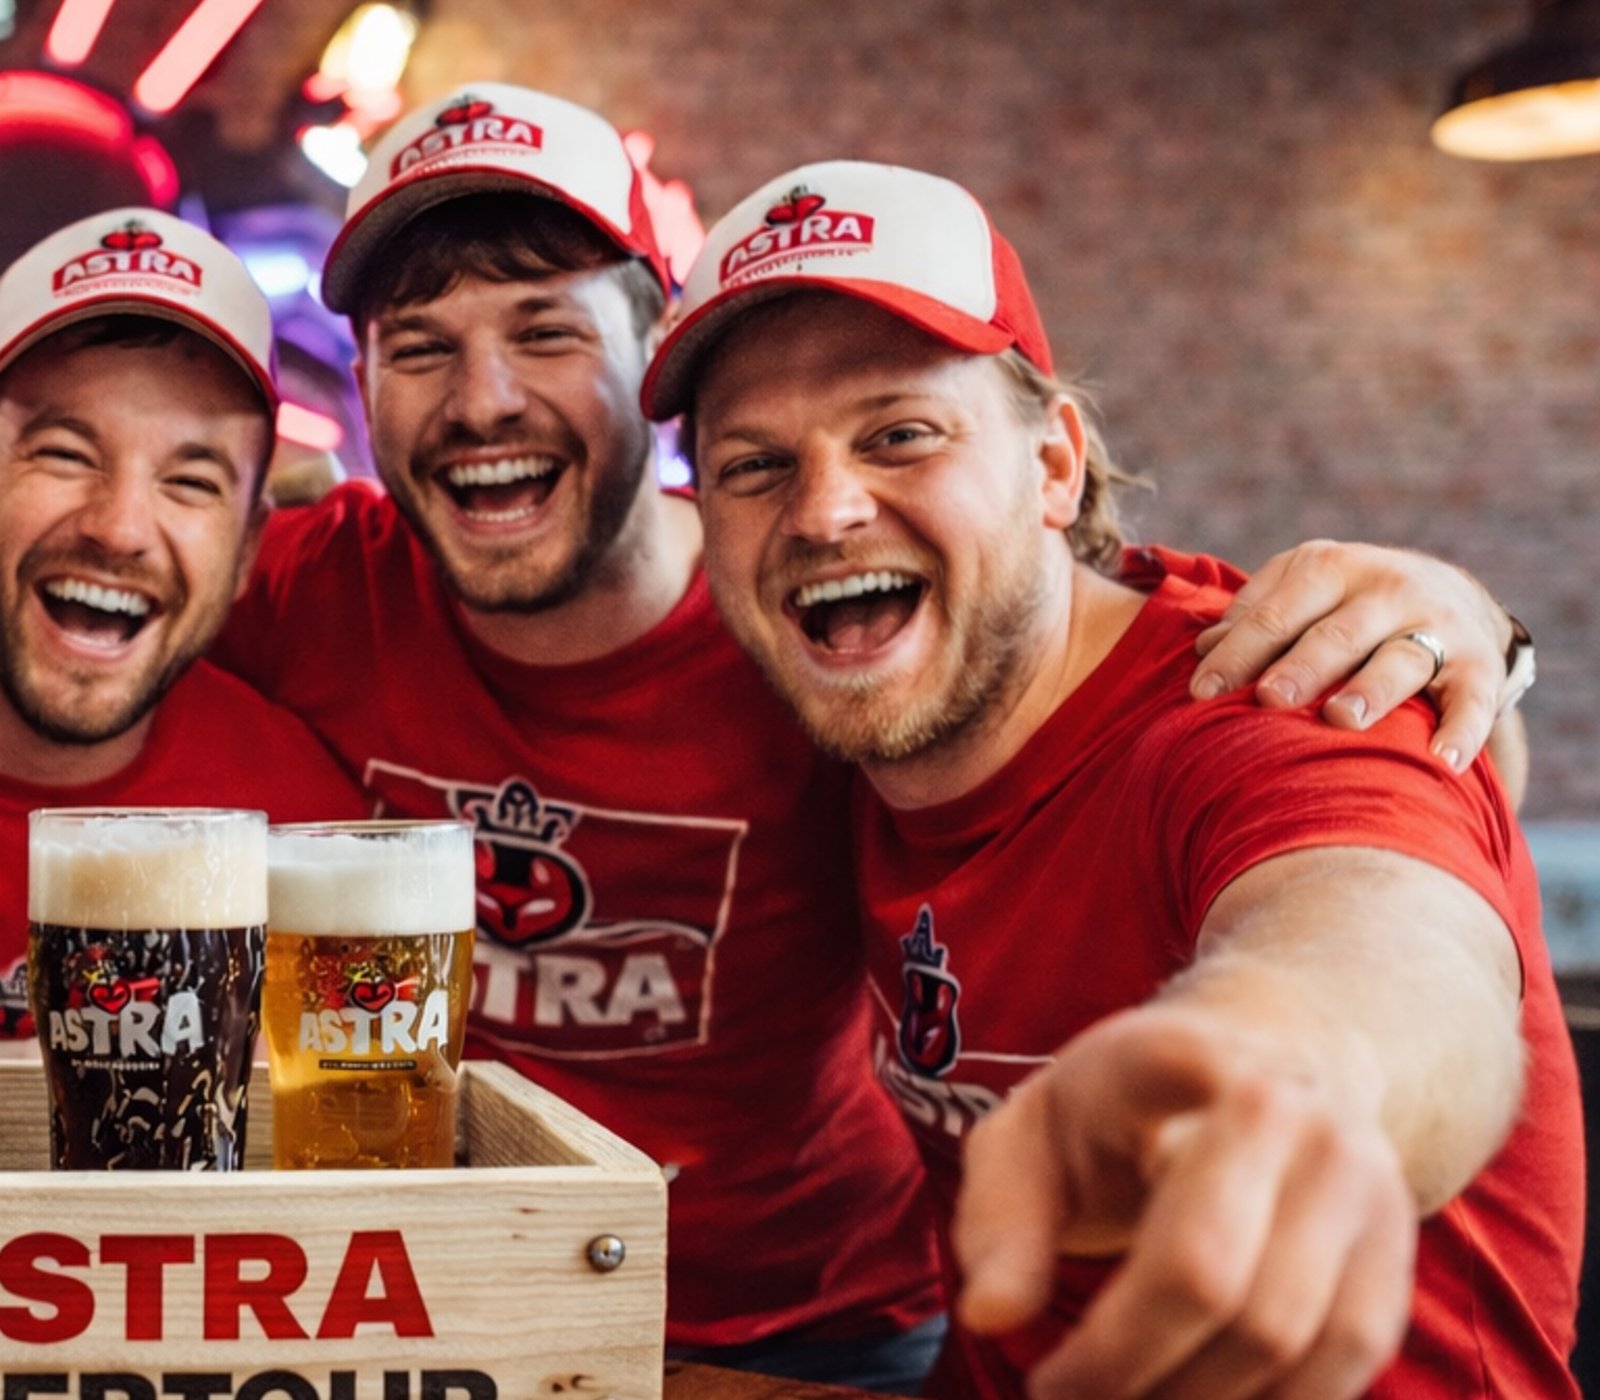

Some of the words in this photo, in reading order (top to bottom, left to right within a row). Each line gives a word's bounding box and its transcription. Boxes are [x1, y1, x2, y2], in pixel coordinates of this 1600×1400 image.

[402, 117, 533, 171] ASTRA
[62, 251, 195, 285] ASTRA
[727, 215, 863, 273] ASTRA
[468, 942, 686, 1027] TRA
[49, 988, 205, 1057] ASTRA
[299, 989, 448, 1055] ASTRA
